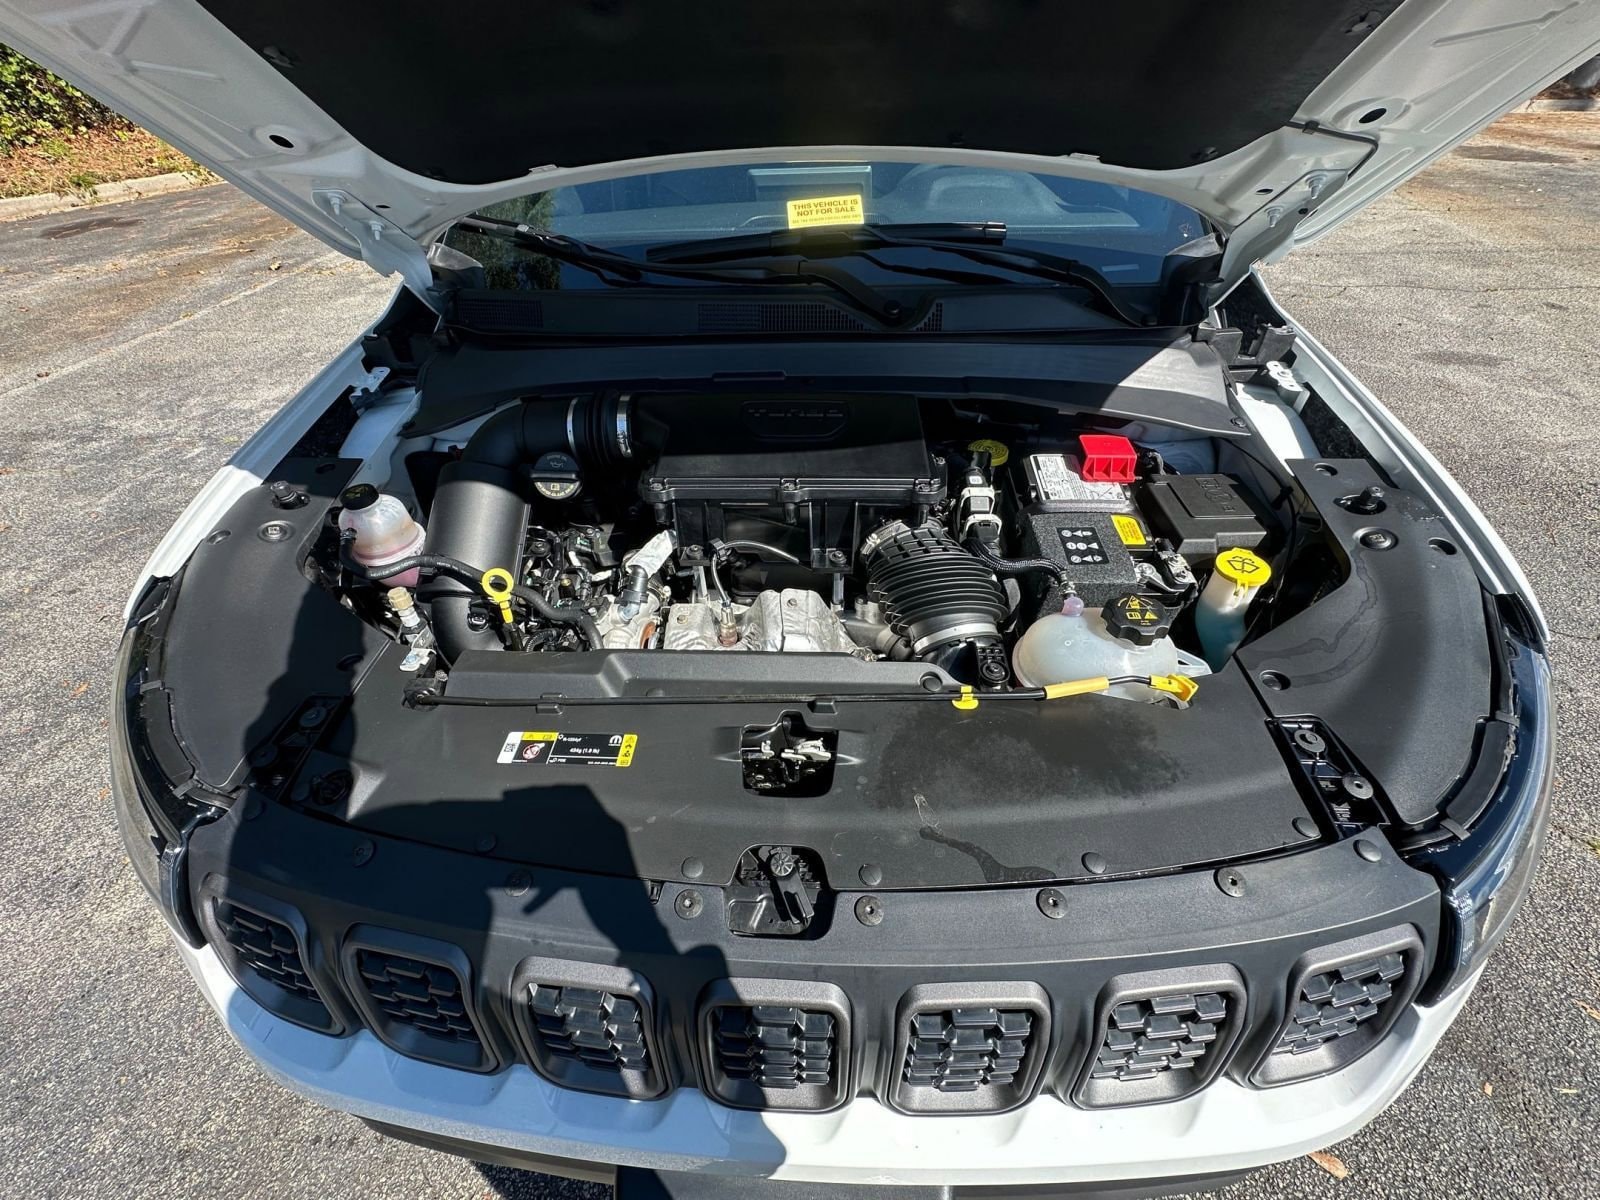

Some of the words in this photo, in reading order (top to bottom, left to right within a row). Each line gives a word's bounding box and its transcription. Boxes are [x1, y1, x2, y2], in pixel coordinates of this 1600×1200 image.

[792, 203, 812, 211] THIS
[813, 200, 849, 209] VEHICLE
[850, 198, 858, 206] IS
[796, 209, 813, 217] NOT
[815, 207, 833, 215] FOR
[834, 205, 856, 213] SALE
